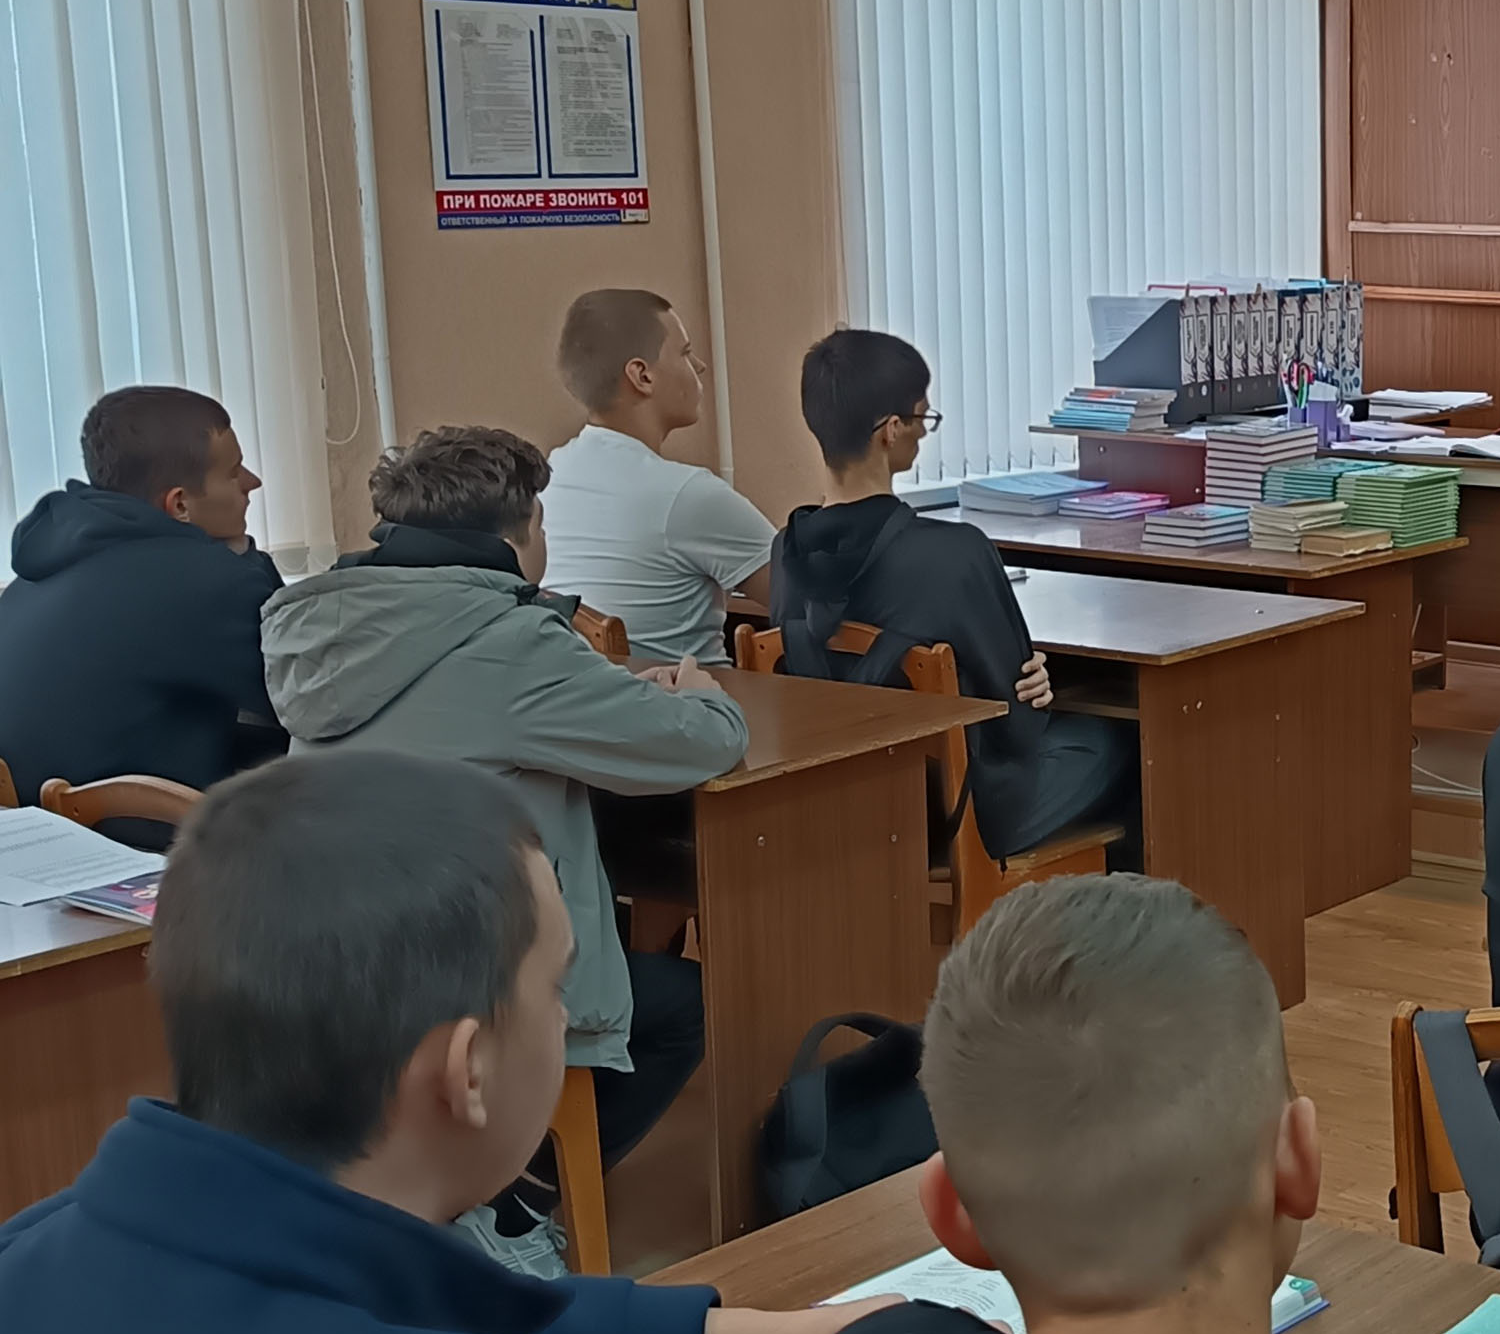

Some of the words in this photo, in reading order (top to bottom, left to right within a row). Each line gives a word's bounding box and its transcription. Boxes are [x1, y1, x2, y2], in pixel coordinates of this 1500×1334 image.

[443, 194, 475, 209] ПРИ
[480, 193, 545, 208] ПОЖАРЕ
[549, 192, 617, 207] ЗВОНИТЬ
[621, 191, 644, 205] 101
[440, 215, 507, 227] ОТВЕТСТВЕННЫЙ
[508, 215, 519, 225] ЗА
[564, 212, 620, 224] БЕЗОПАСНОСТЬ
